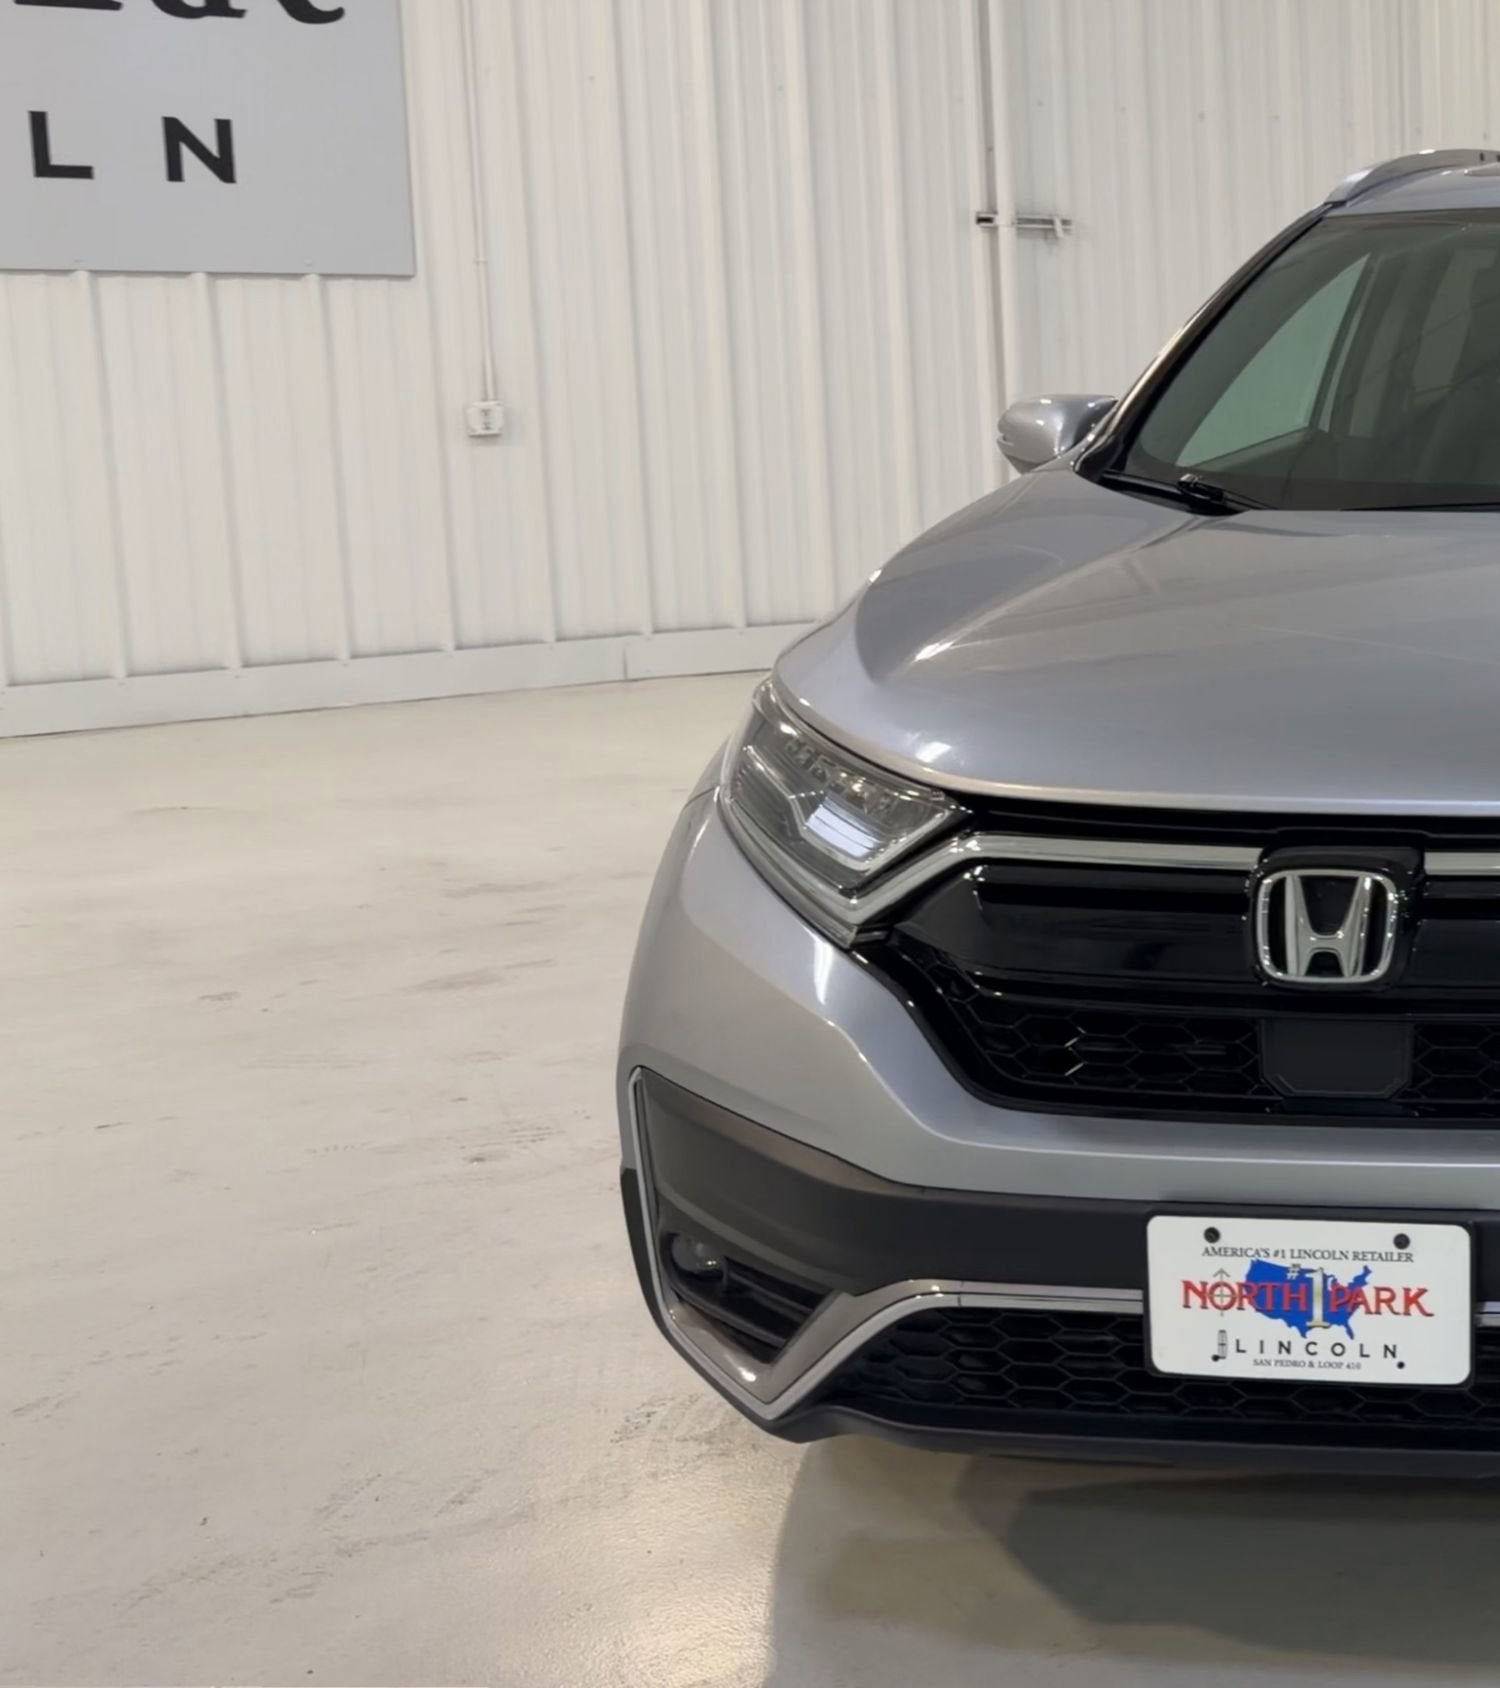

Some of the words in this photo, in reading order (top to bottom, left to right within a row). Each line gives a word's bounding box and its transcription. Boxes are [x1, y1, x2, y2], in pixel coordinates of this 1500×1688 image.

[1202, 1246, 1270, 1258] AMERICA'S
[1273, 1248, 1286, 1259] #1
[1290, 1249, 1349, 1261] LINCOLN
[1352, 1250, 1414, 1262] RETAILER
[1182, 1280, 1308, 1312] NORTH
[1330, 1283, 1435, 1317] PARK
[1235, 1339, 1398, 1358] LINCOLN
[1253, 1359, 1271, 1367] SAN
